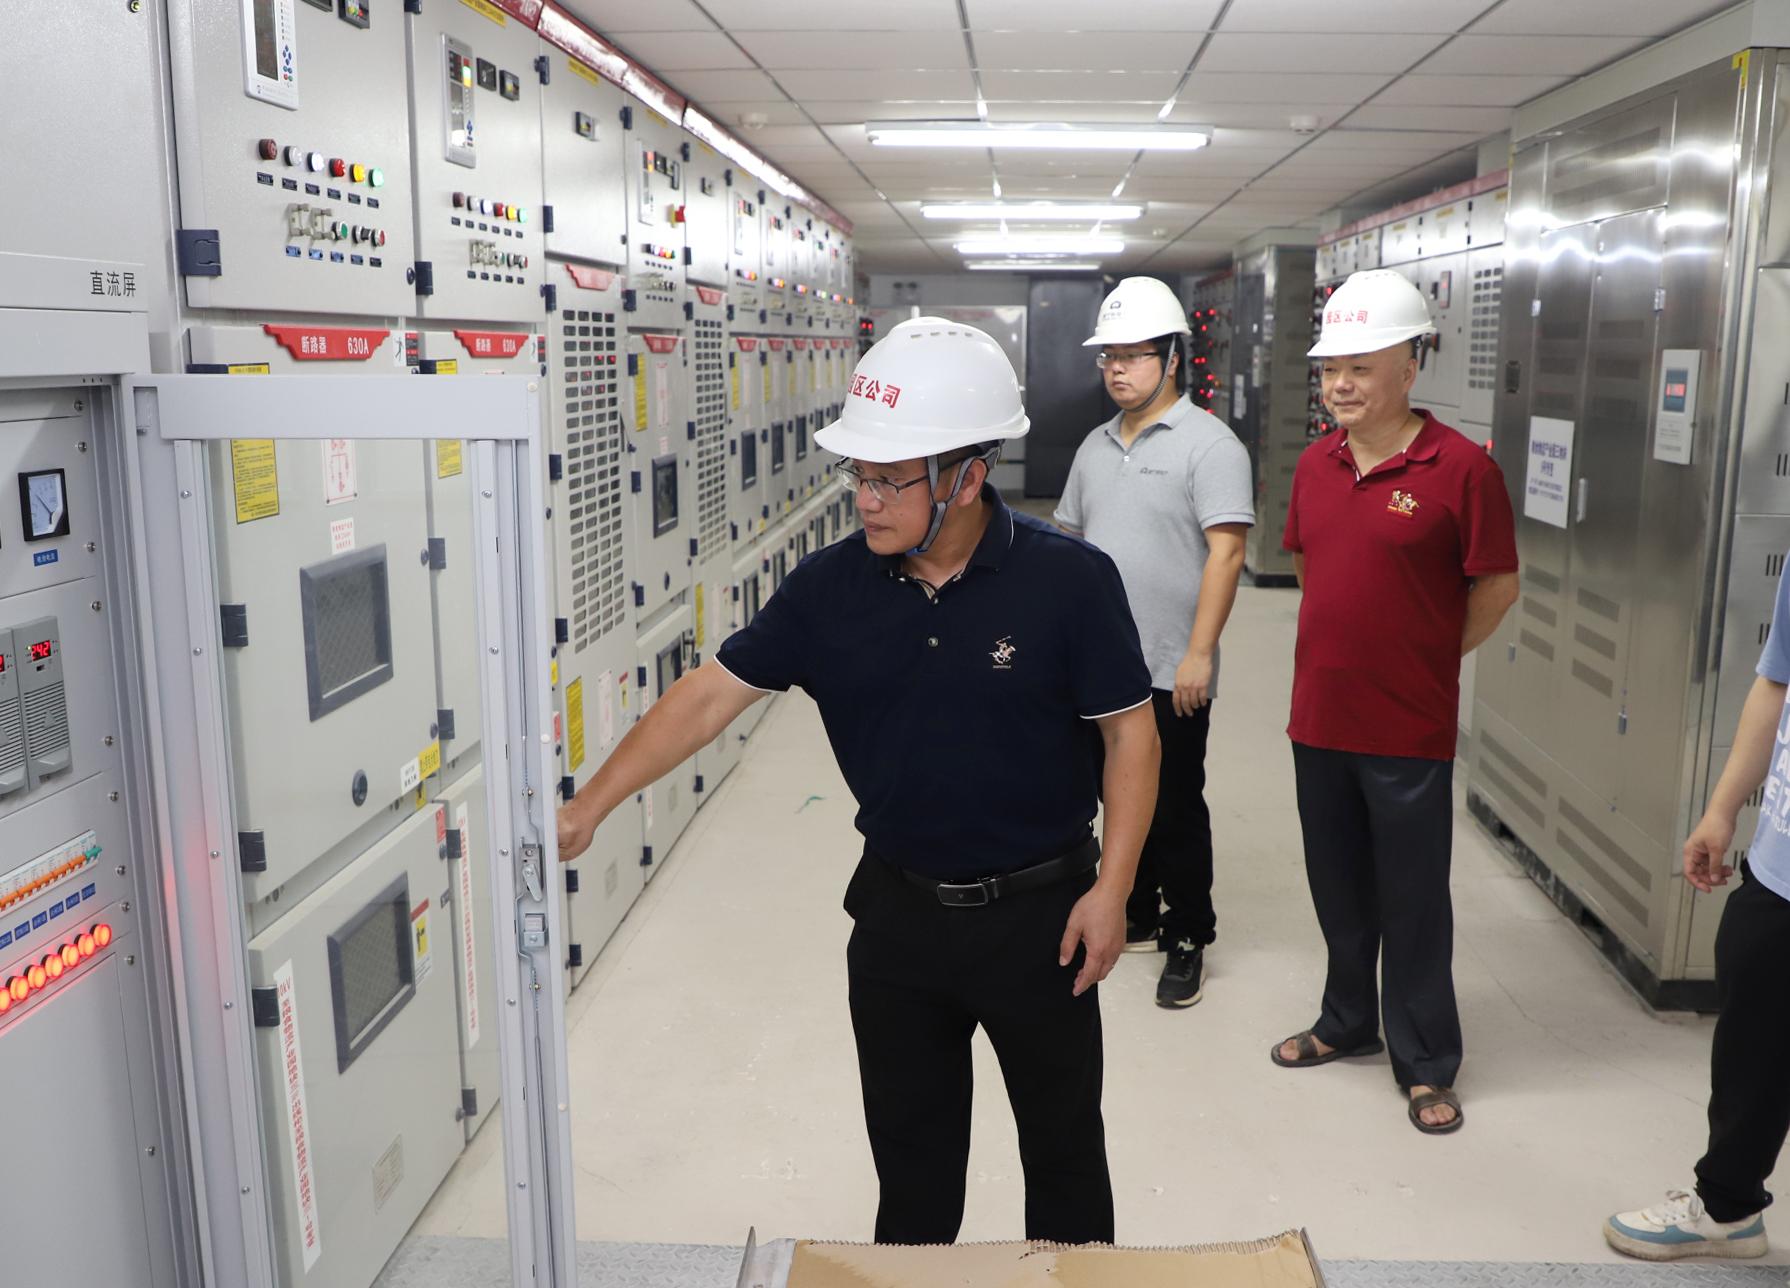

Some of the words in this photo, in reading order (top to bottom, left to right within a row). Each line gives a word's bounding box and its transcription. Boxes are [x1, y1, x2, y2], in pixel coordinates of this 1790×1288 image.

[90, 270, 136, 297] 直流屏
[301, 336, 327, 354] 断路器
[347, 337, 369, 354] 630A
[32, 641, 51, 660] 242
